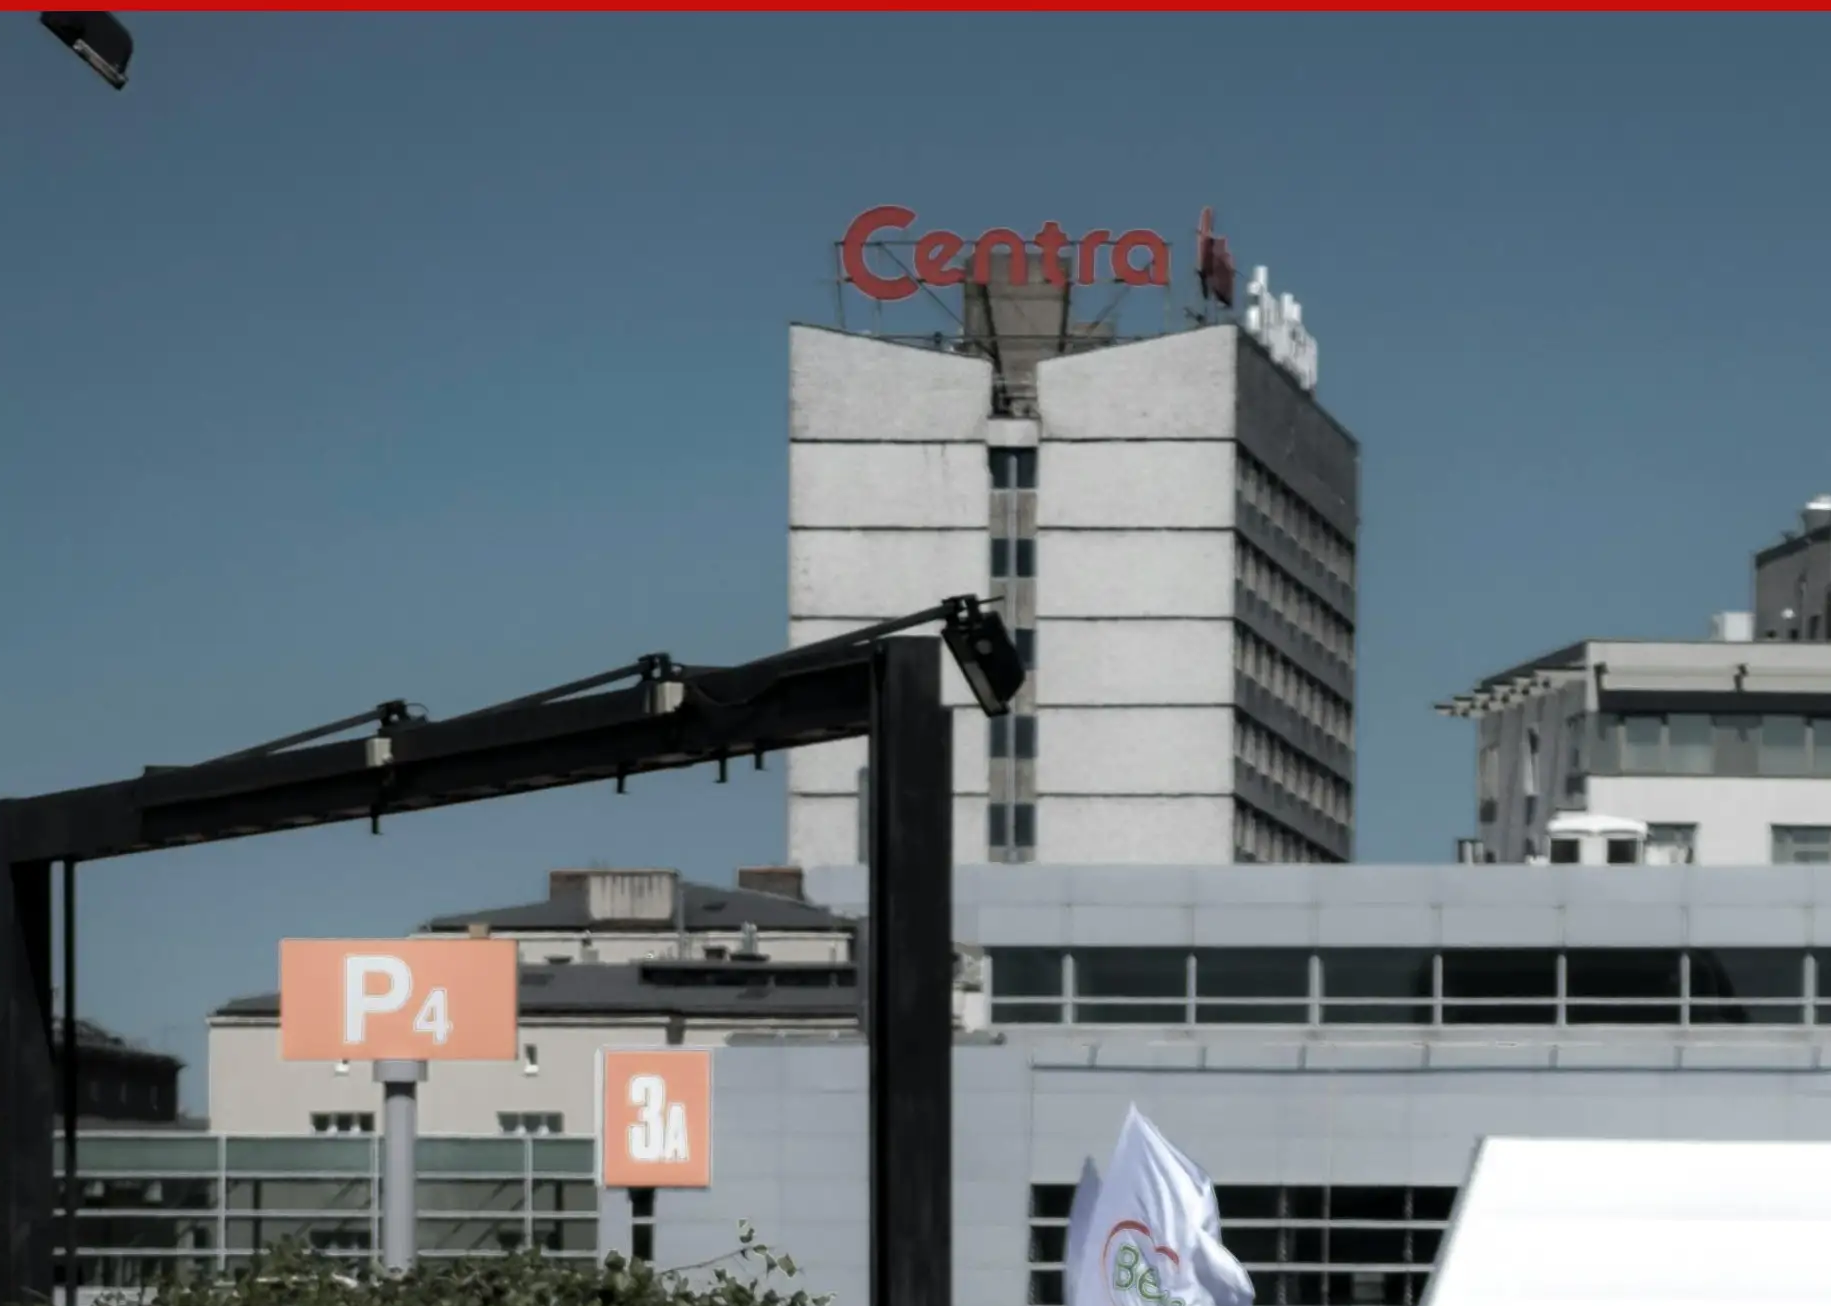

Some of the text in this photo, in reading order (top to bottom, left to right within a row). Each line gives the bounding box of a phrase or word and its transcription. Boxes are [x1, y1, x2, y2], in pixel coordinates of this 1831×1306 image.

[842, 204, 1171, 300] Centra
[342, 954, 453, 1045] P4
[626, 1074, 690, 1163] 3A
